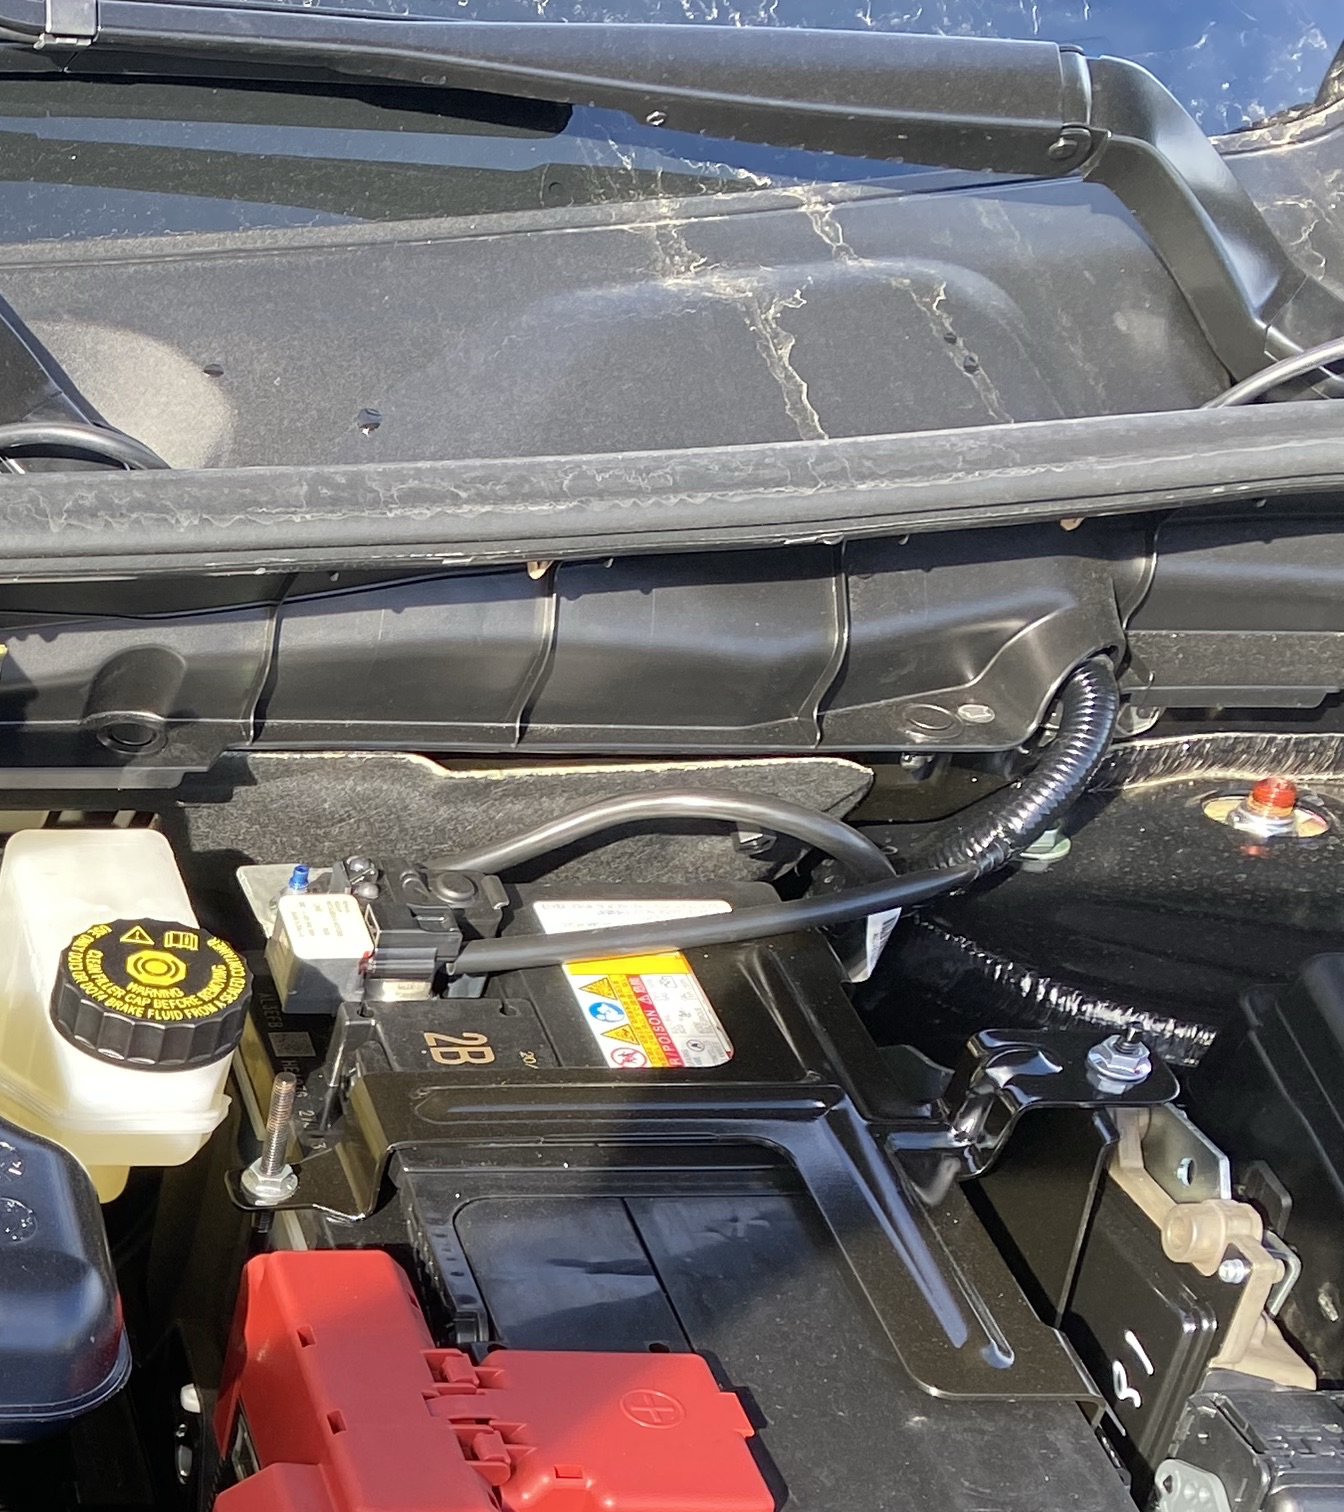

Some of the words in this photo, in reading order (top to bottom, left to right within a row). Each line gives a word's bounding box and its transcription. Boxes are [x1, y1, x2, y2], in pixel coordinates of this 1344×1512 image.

[91, 973, 126, 998] FILLER
[125, 993, 152, 1006] CAP
[153, 994, 200, 1010] BEFORE
[197, 964, 228, 1001] REMOVING
[103, 998, 144, 1017] BRAKE
[147, 1009, 183, 1021] FLUID
[184, 1001, 218, 1020] FROM
[220, 977, 246, 1004] SEALED
[126, 981, 184, 998] WARNING
[424, 1032, 496, 1066] 2B
